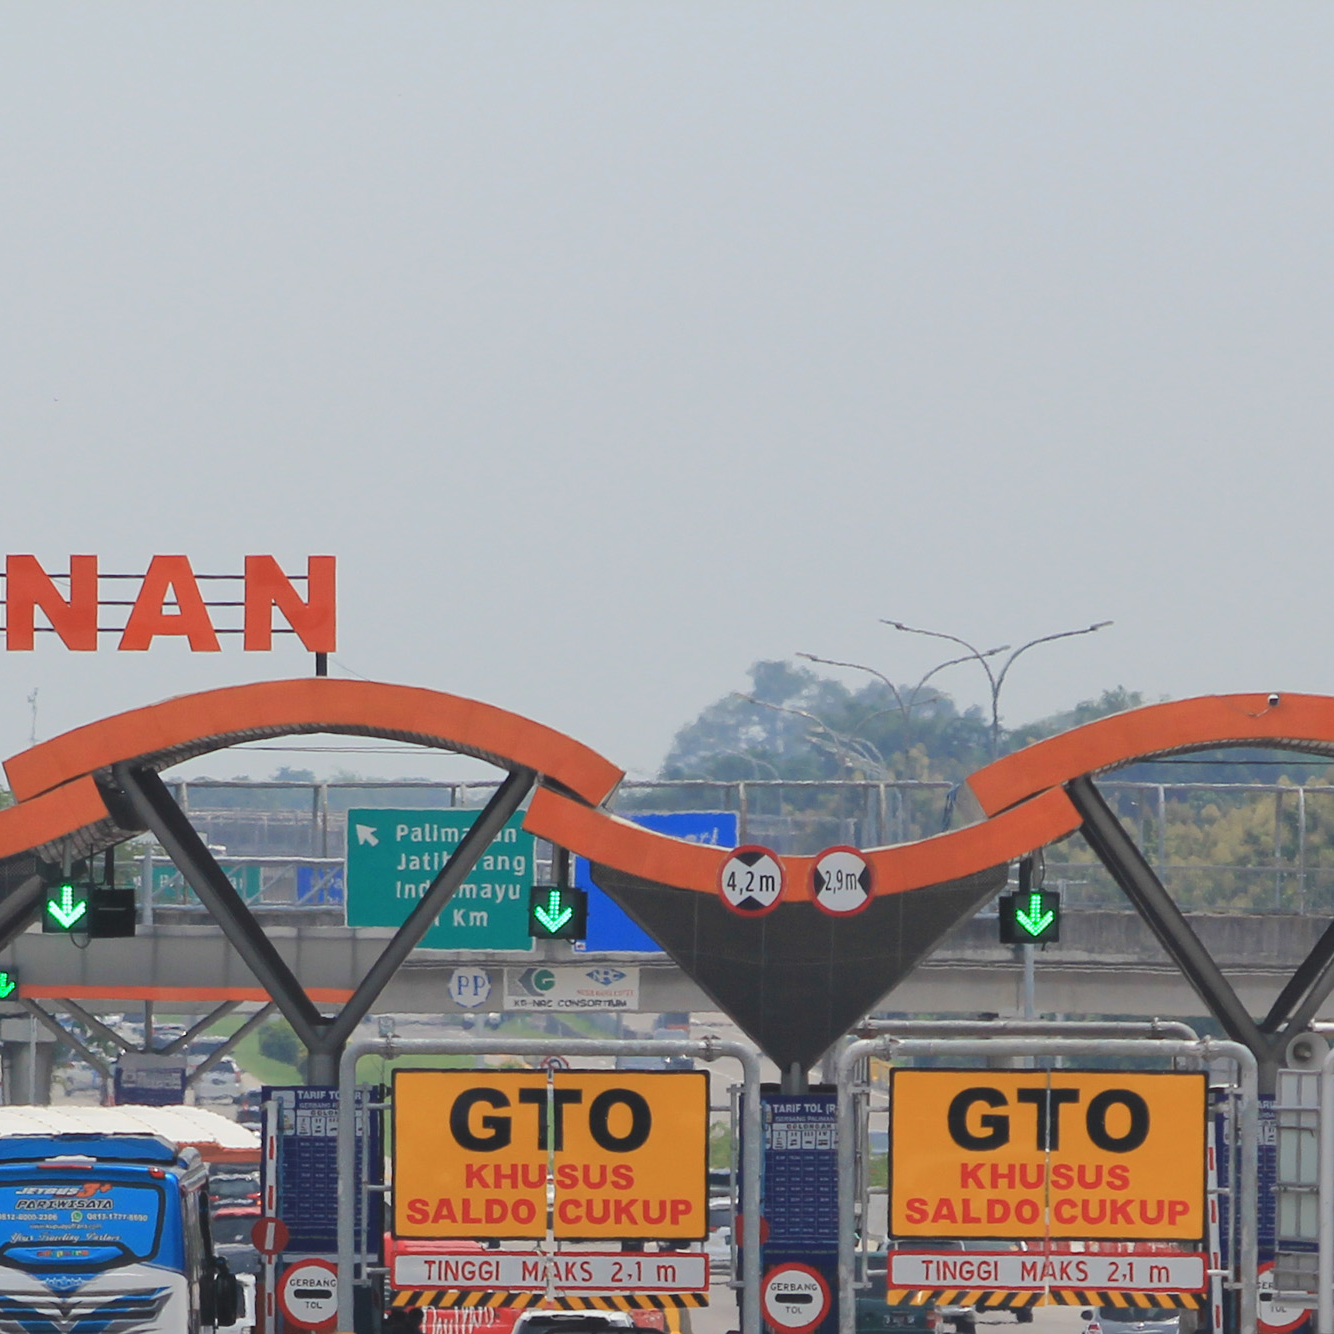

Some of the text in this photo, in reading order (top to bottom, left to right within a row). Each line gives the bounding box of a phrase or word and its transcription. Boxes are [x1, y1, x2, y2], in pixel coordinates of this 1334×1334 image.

[396, 880, 521, 903] Indmayu
[453, 909, 488, 926] Km
[297, 1091, 326, 1100] TARIF
[449, 1087, 652, 1153] GTO
[773, 1104, 823, 1113] TARIF TOL
[947, 1087, 1150, 1154] GTO
[465, 1163, 634, 1190] KHUSUS
[960, 1162, 1130, 1191] KHUSUS
[15, 1199, 114, 1210] PARIWISATA
[406, 1198, 692, 1225] SALDO CUKUP
[905, 1198, 1190, 1226] SALDO CUKUP
[290, 1279, 337, 1287] GERBANG
[424, 1260, 677, 1283] TINGGI MAKS 2,1 m
[921, 1260, 1170, 1283] TINGGI MAKS 2,1 m
[771, 1283, 818, 1291] GERBANG
[786, 1306, 803, 1314] TOL
